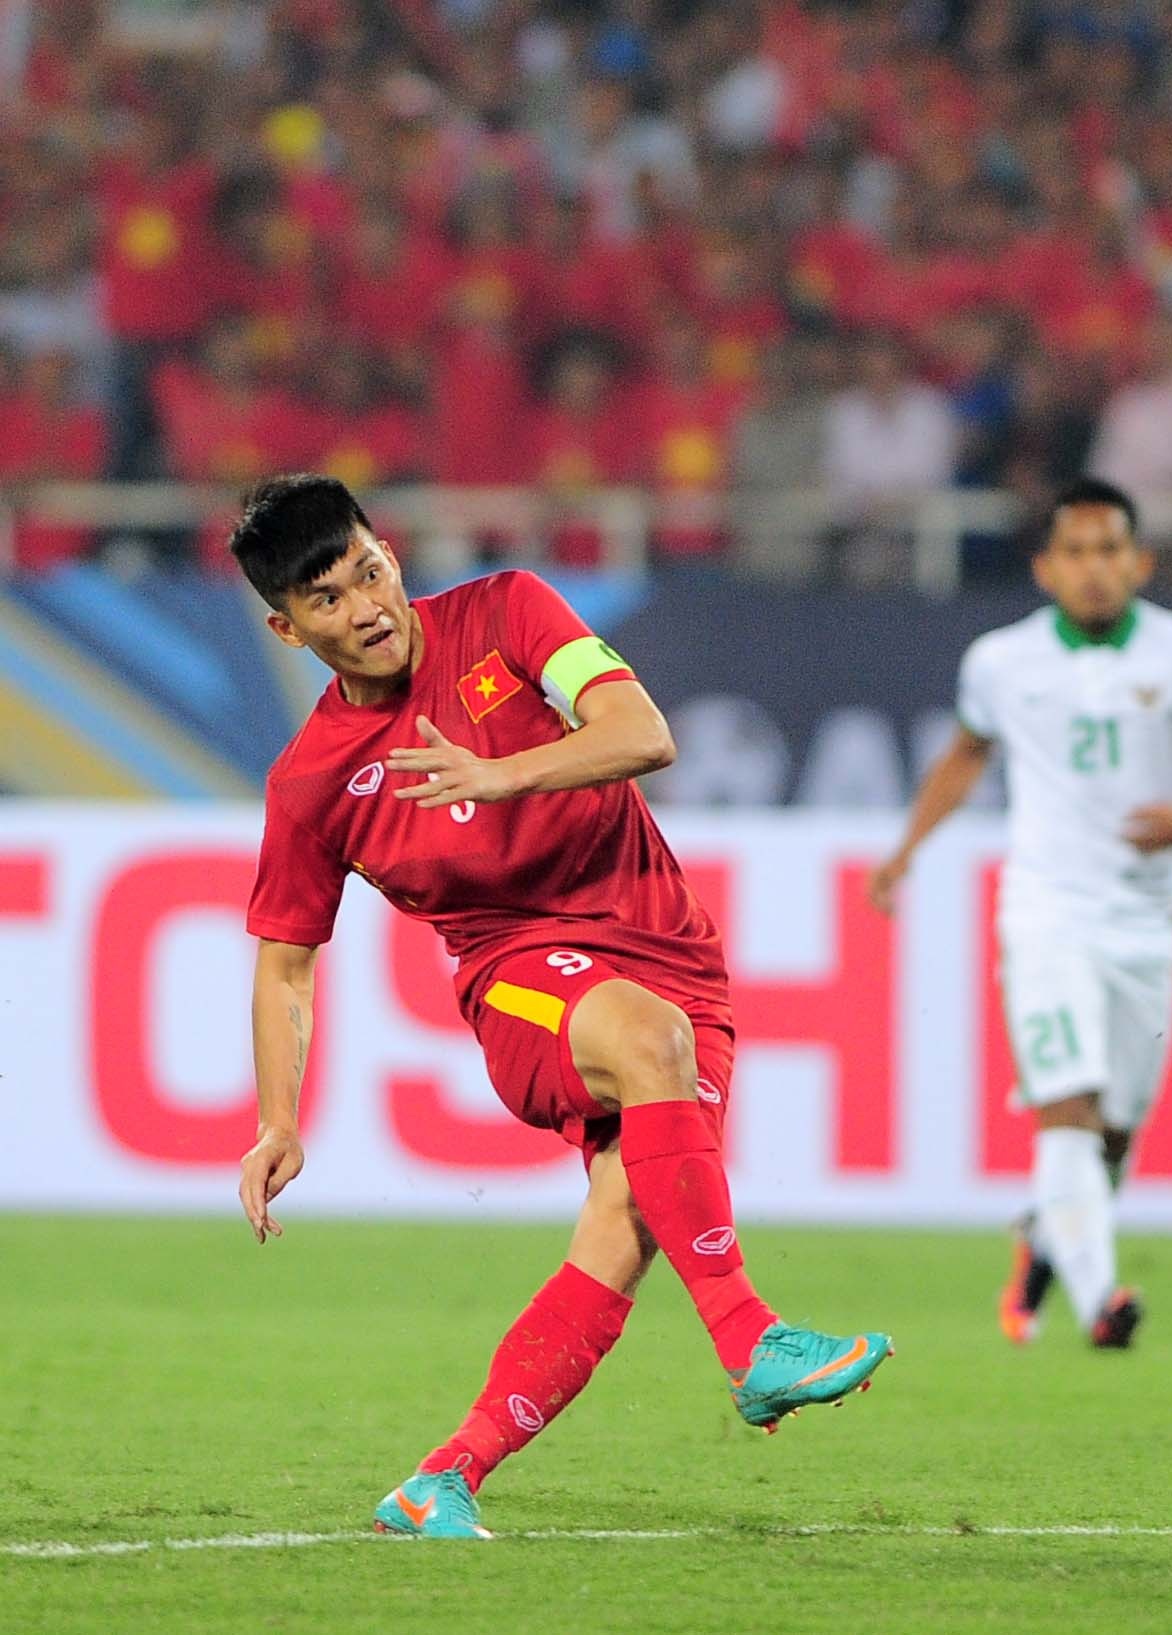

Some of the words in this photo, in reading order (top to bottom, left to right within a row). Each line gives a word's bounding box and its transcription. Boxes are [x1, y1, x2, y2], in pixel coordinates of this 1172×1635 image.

[1069, 714, 1122, 774] 21
[546, 951, 593, 976] 9
[1026, 1002, 1080, 1070] 21
